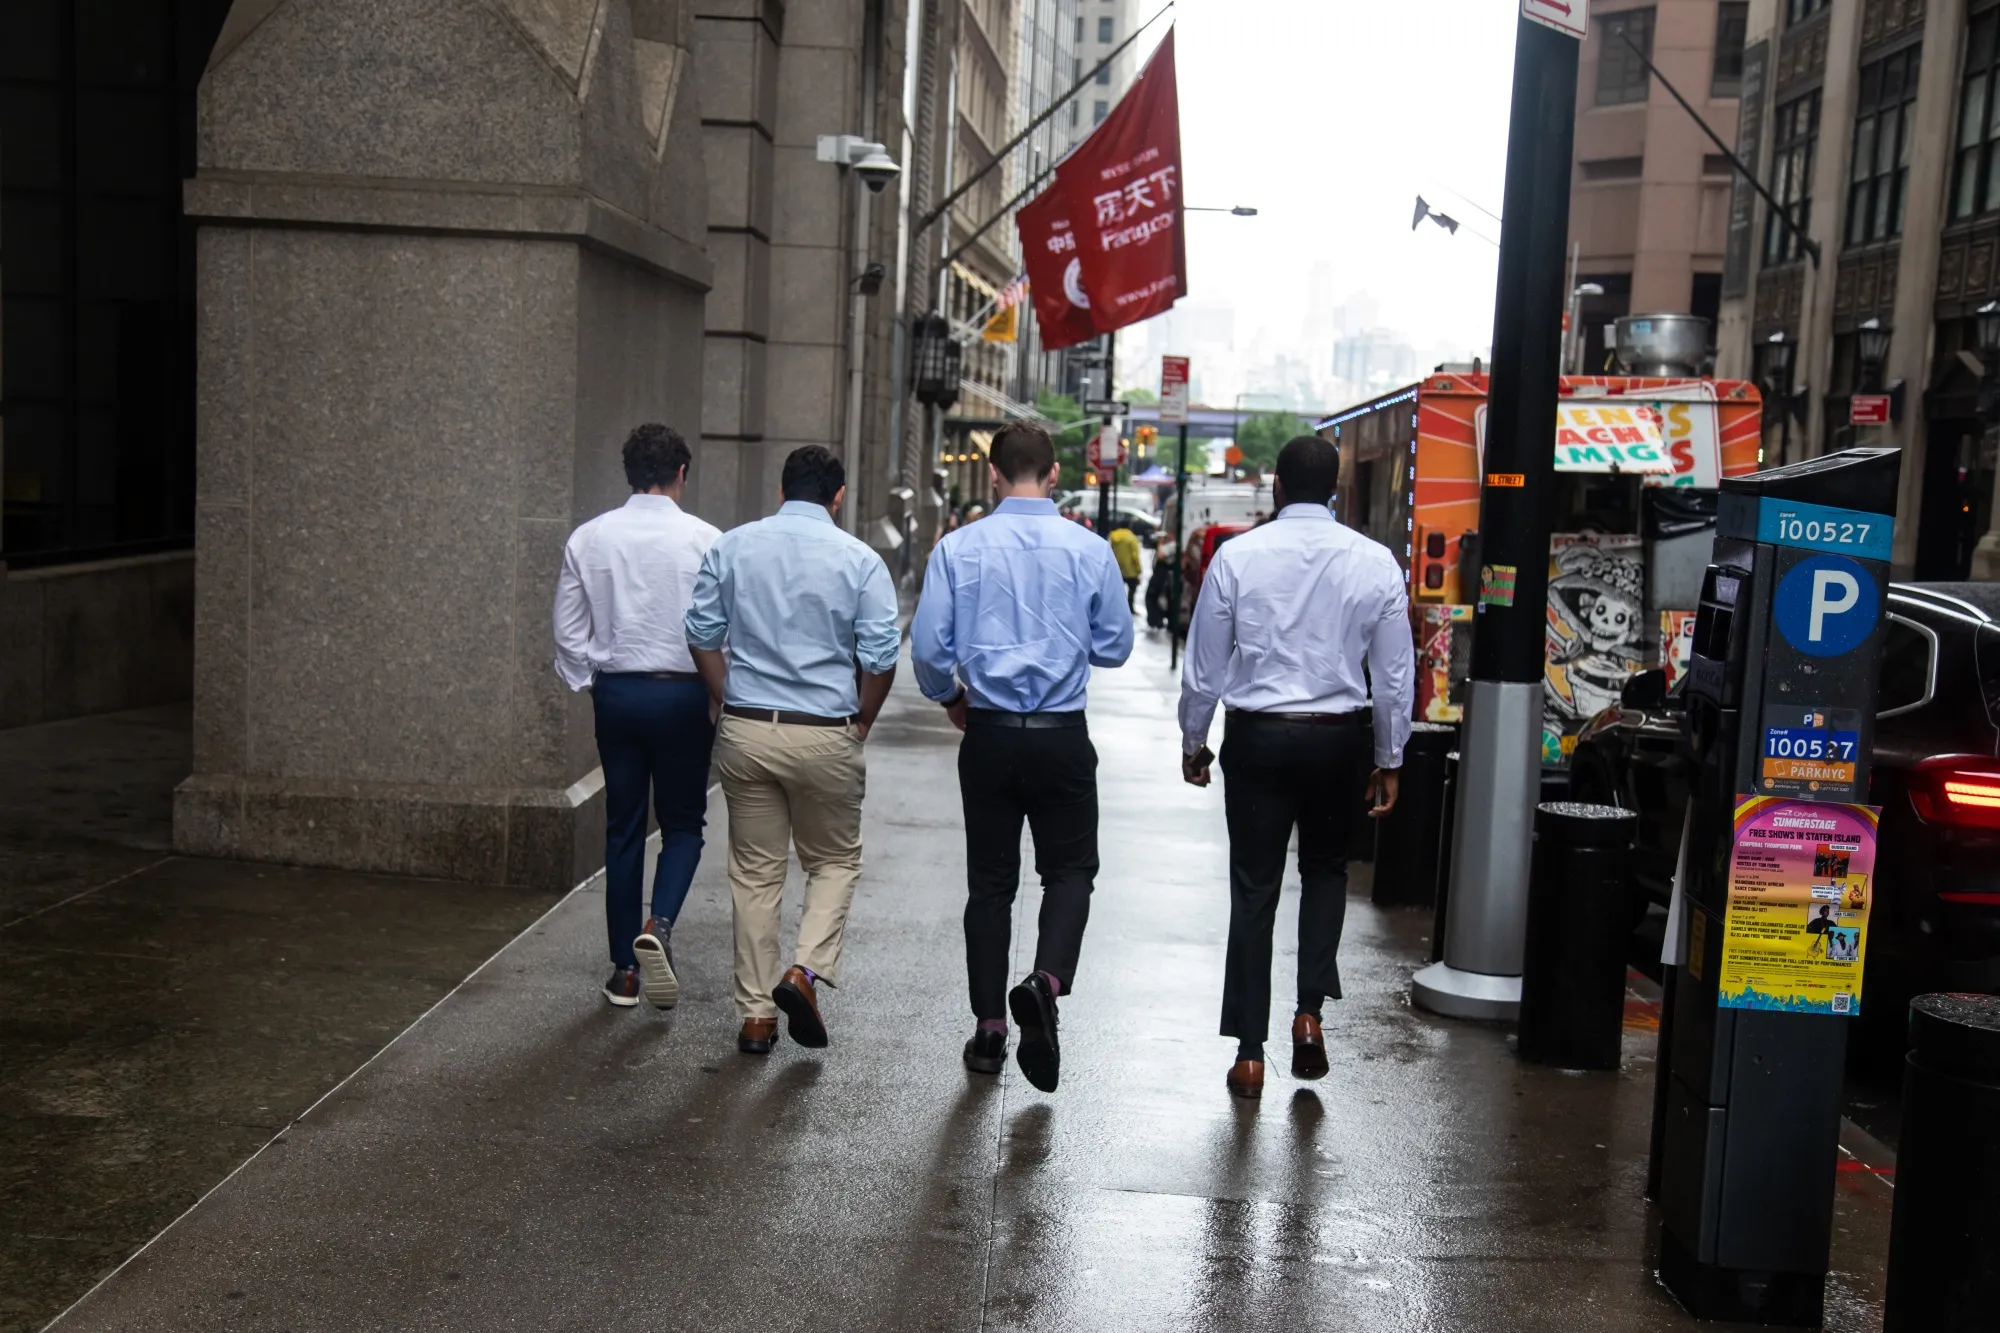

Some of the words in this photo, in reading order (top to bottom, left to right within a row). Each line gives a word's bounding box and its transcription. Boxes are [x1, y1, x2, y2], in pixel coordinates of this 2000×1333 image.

[1497, 474, 1522, 485] STREET
[1780, 520, 1870, 544] 100527
[1808, 570, 1860, 642] P
[1790, 766, 1846, 780] PARKNYC
[1772, 816, 1837, 830] SUMMERSTAGE
[1749, 829, 1766, 838] FREE
[1768, 830, 1794, 839] SHOWS
[1797, 832, 1804, 840] IN
[1806, 832, 1832, 842] STATEN
[1834, 834, 1861, 843] ISLAND
